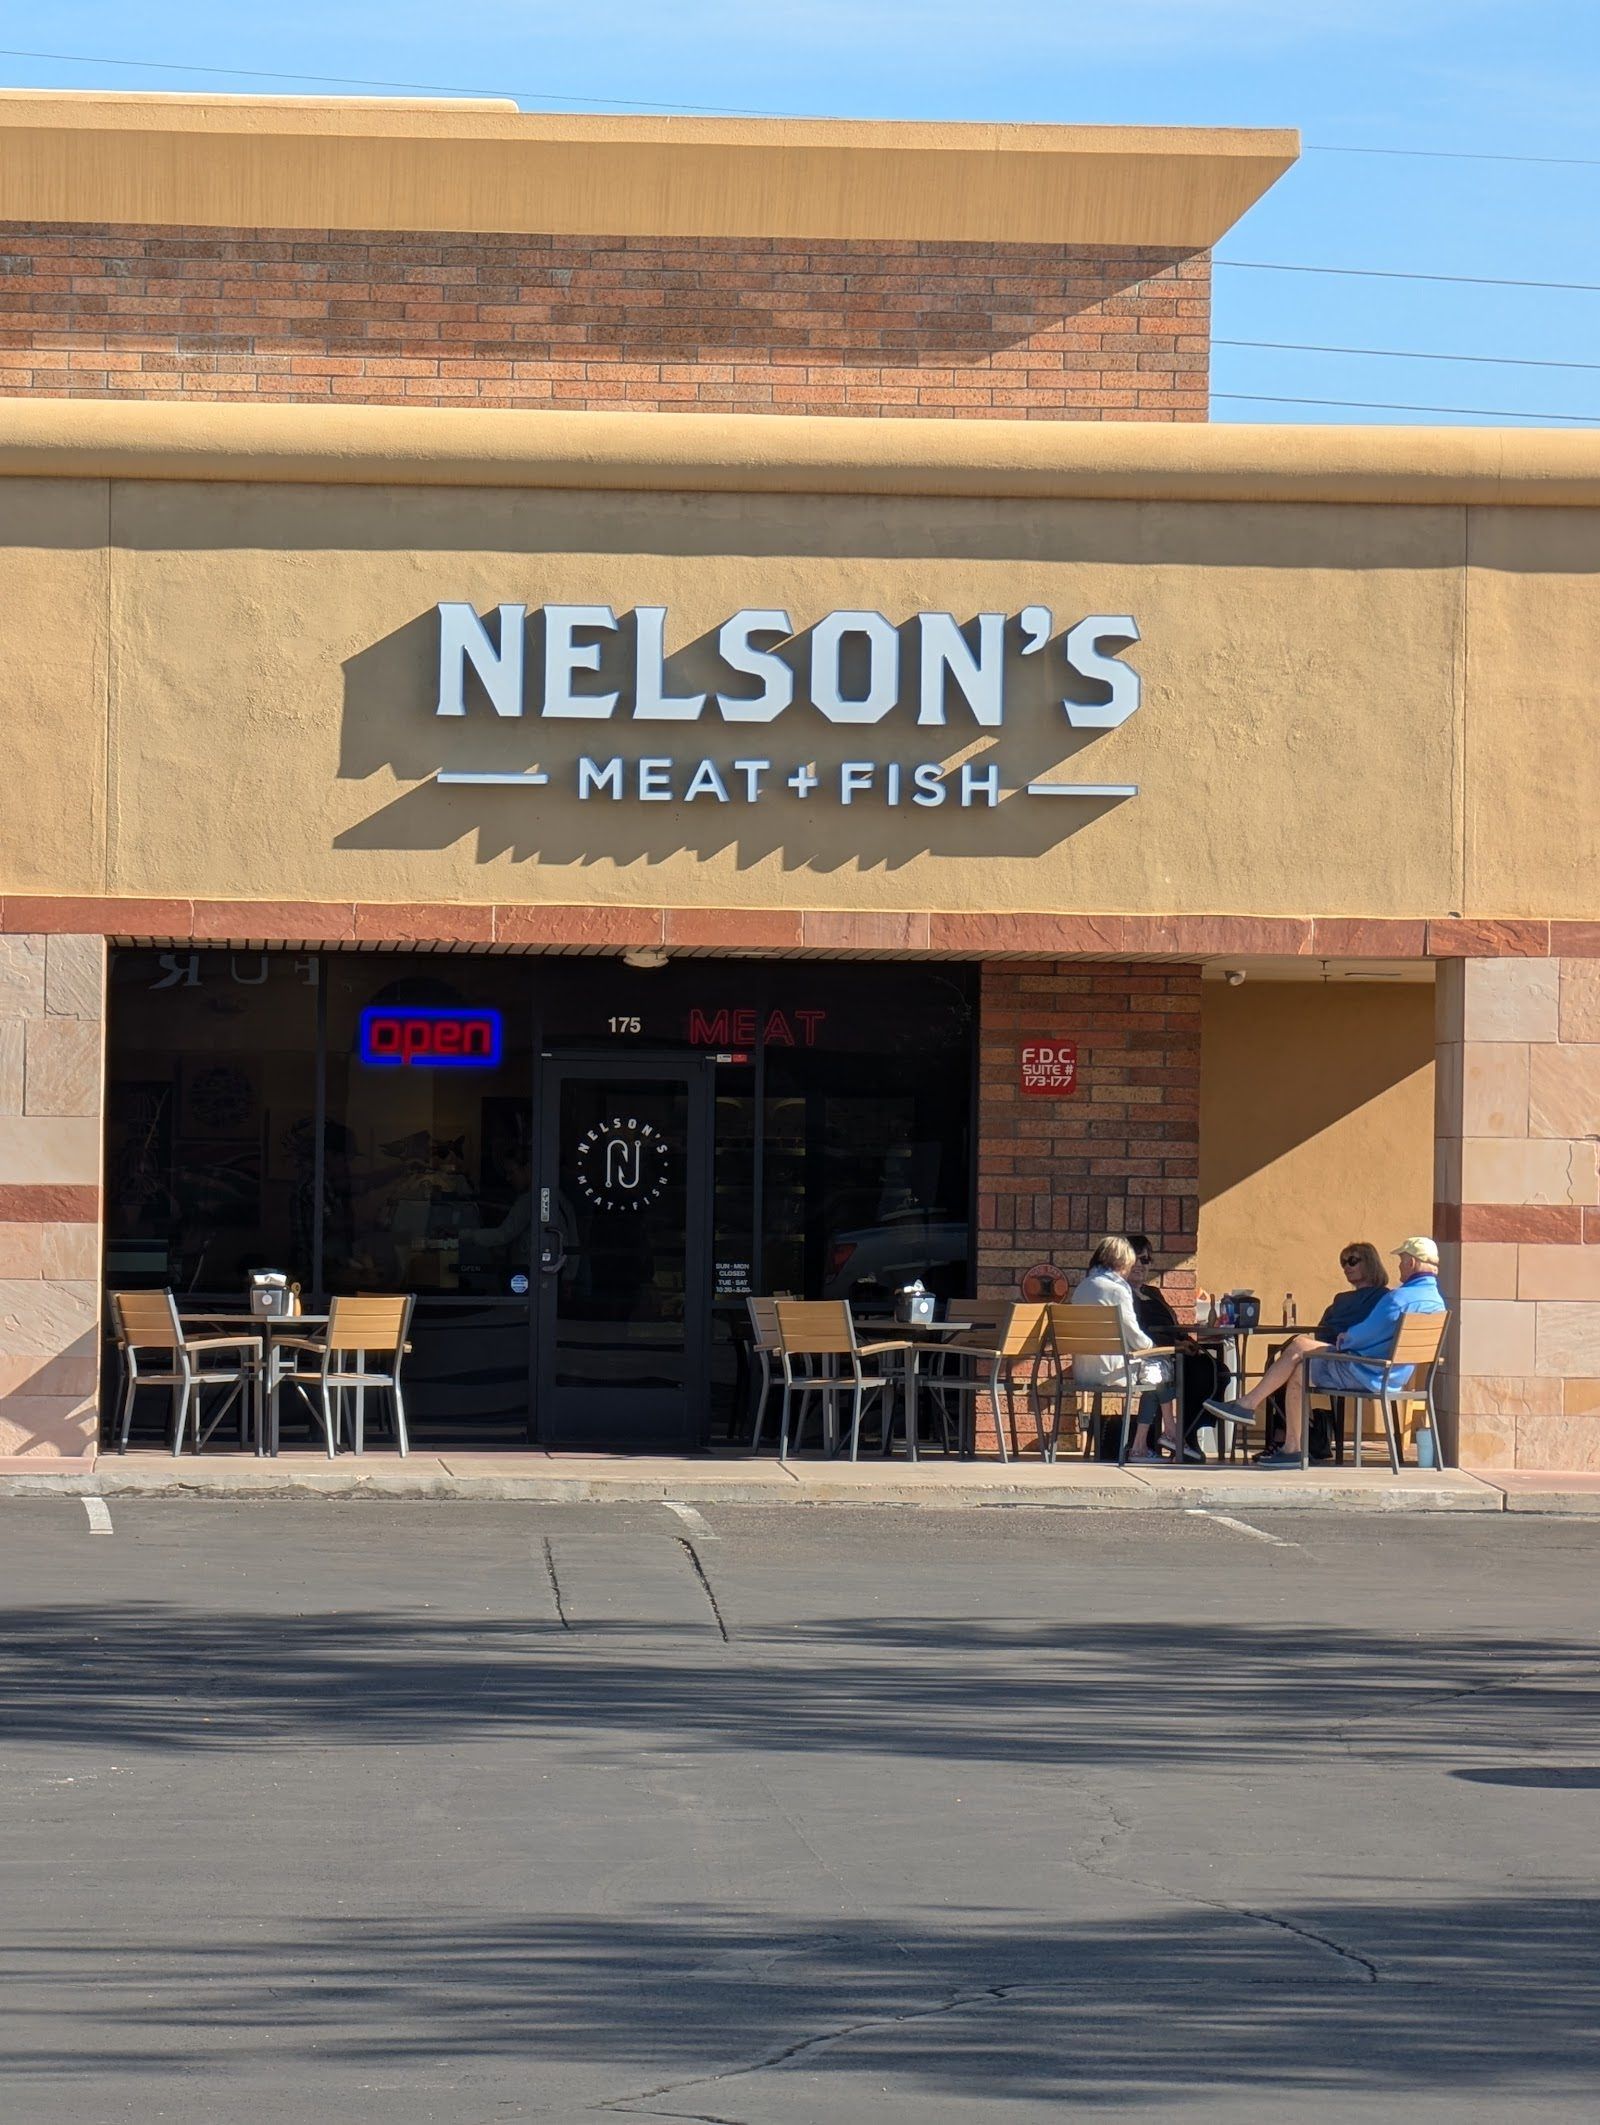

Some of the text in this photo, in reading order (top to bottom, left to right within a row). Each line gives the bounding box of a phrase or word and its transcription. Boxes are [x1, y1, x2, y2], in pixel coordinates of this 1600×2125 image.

[436, 602, 1141, 727] NELSON'S
[578, 757, 999, 808] MEAT + FISH
[371, 1019, 491, 1066] open
[608, 1017, 642, 1034] 175
[690, 1009, 826, 1046] MEAT
[1022, 1048, 1076, 1064] F.D.C.
[1022, 1064, 1074, 1075] SUITE #
[1025, 1076, 1072, 1087] 173-177
[578, 1118, 668, 1154] NELSON'S
[577, 1175, 613, 1210] MEAT
[632, 1176, 668, 1211] FISH
